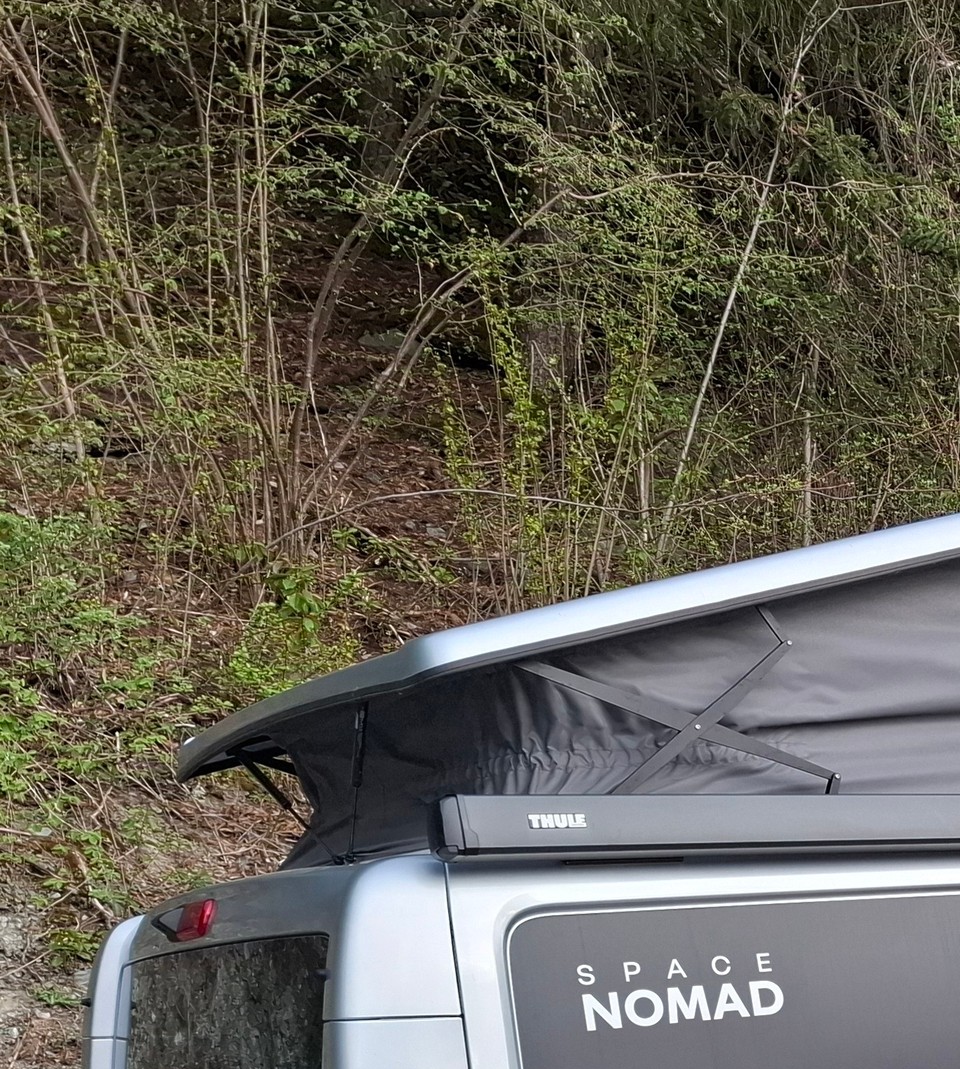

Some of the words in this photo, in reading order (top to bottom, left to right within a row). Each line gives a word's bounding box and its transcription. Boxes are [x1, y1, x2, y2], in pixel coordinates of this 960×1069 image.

[528, 813, 587, 829] THULE
[576, 952, 773, 986] SPACE
[581, 980, 785, 1032] NOMAD
